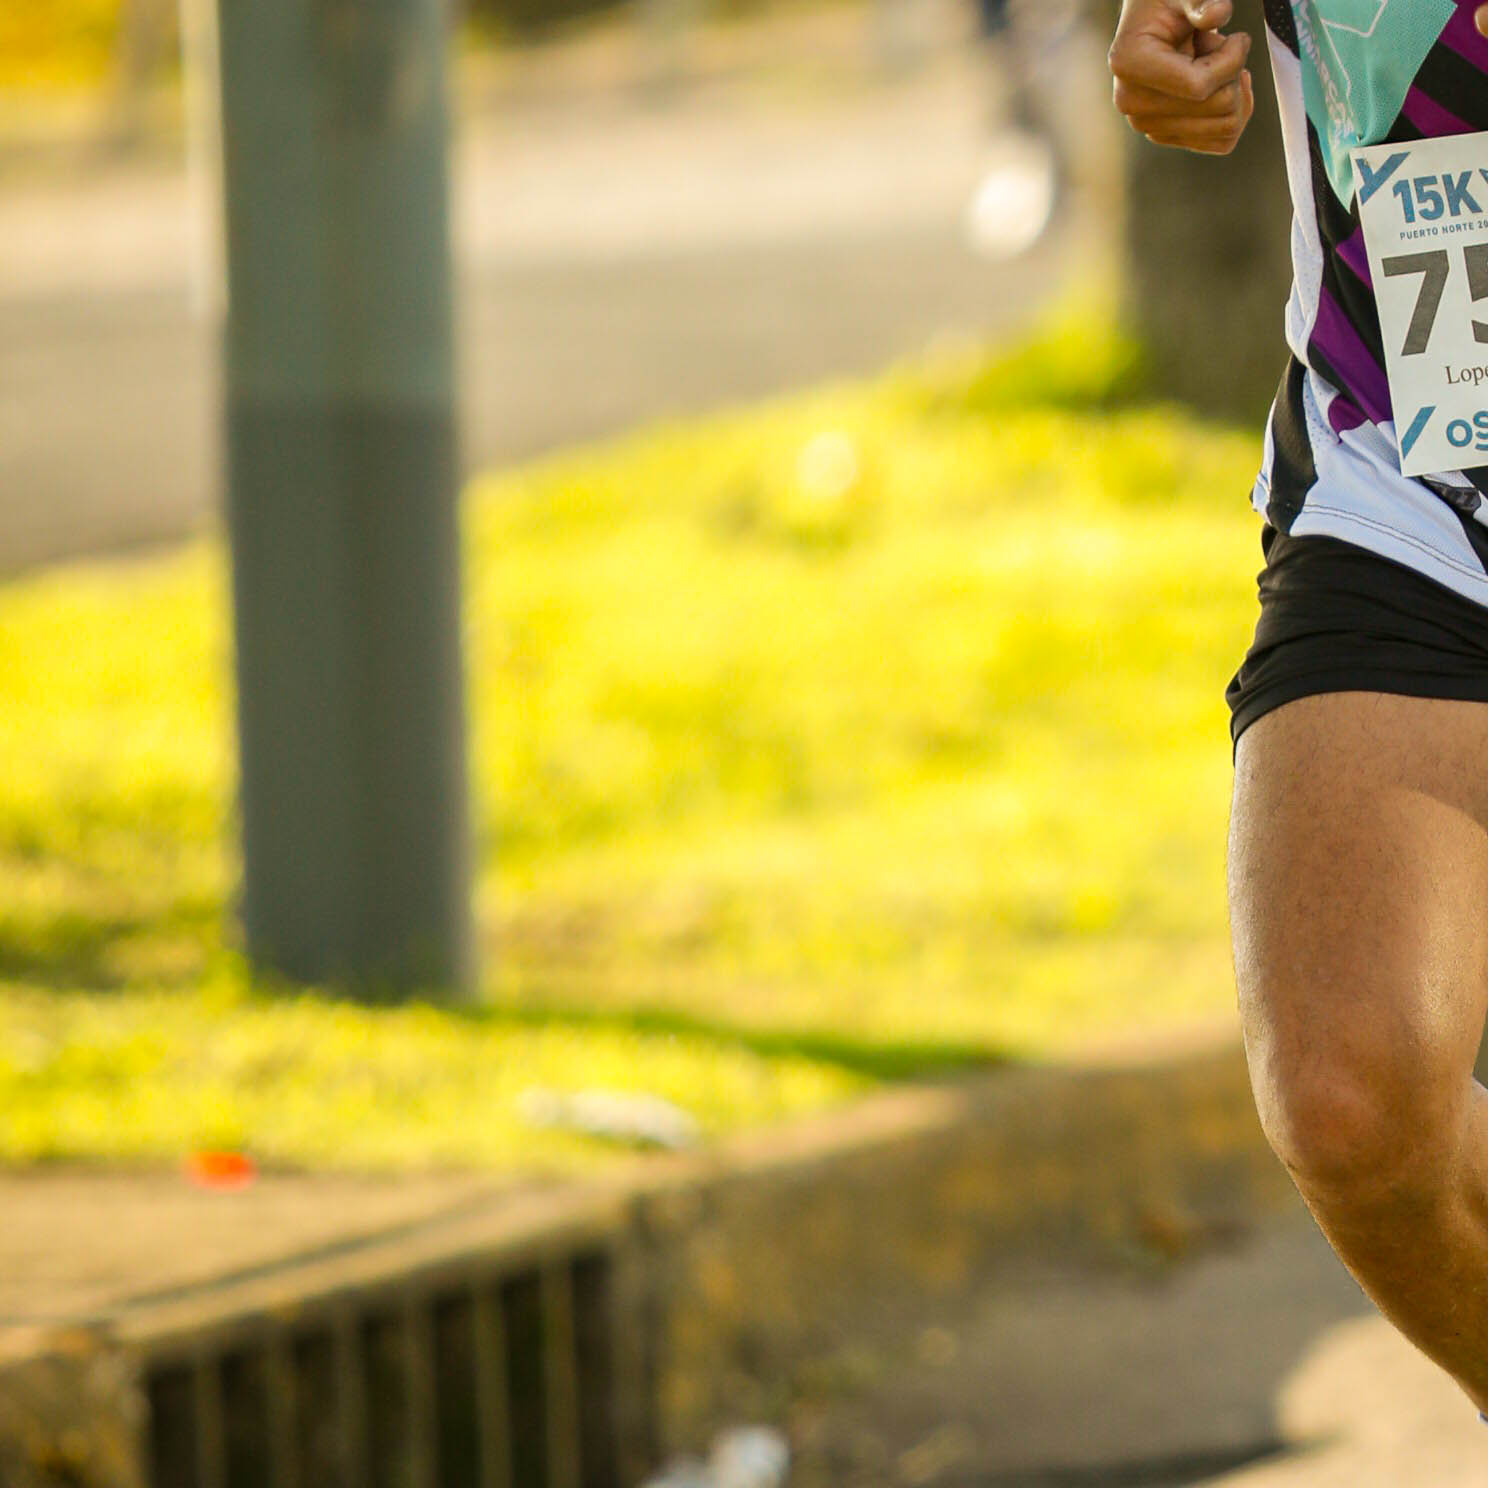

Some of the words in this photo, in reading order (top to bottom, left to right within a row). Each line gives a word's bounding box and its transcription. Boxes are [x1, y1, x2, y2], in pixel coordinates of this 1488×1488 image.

[1393, 170, 1483, 223] 15K
[1400, 227, 1438, 240] PUERTO
[1442, 222, 1475, 235] NORTE
